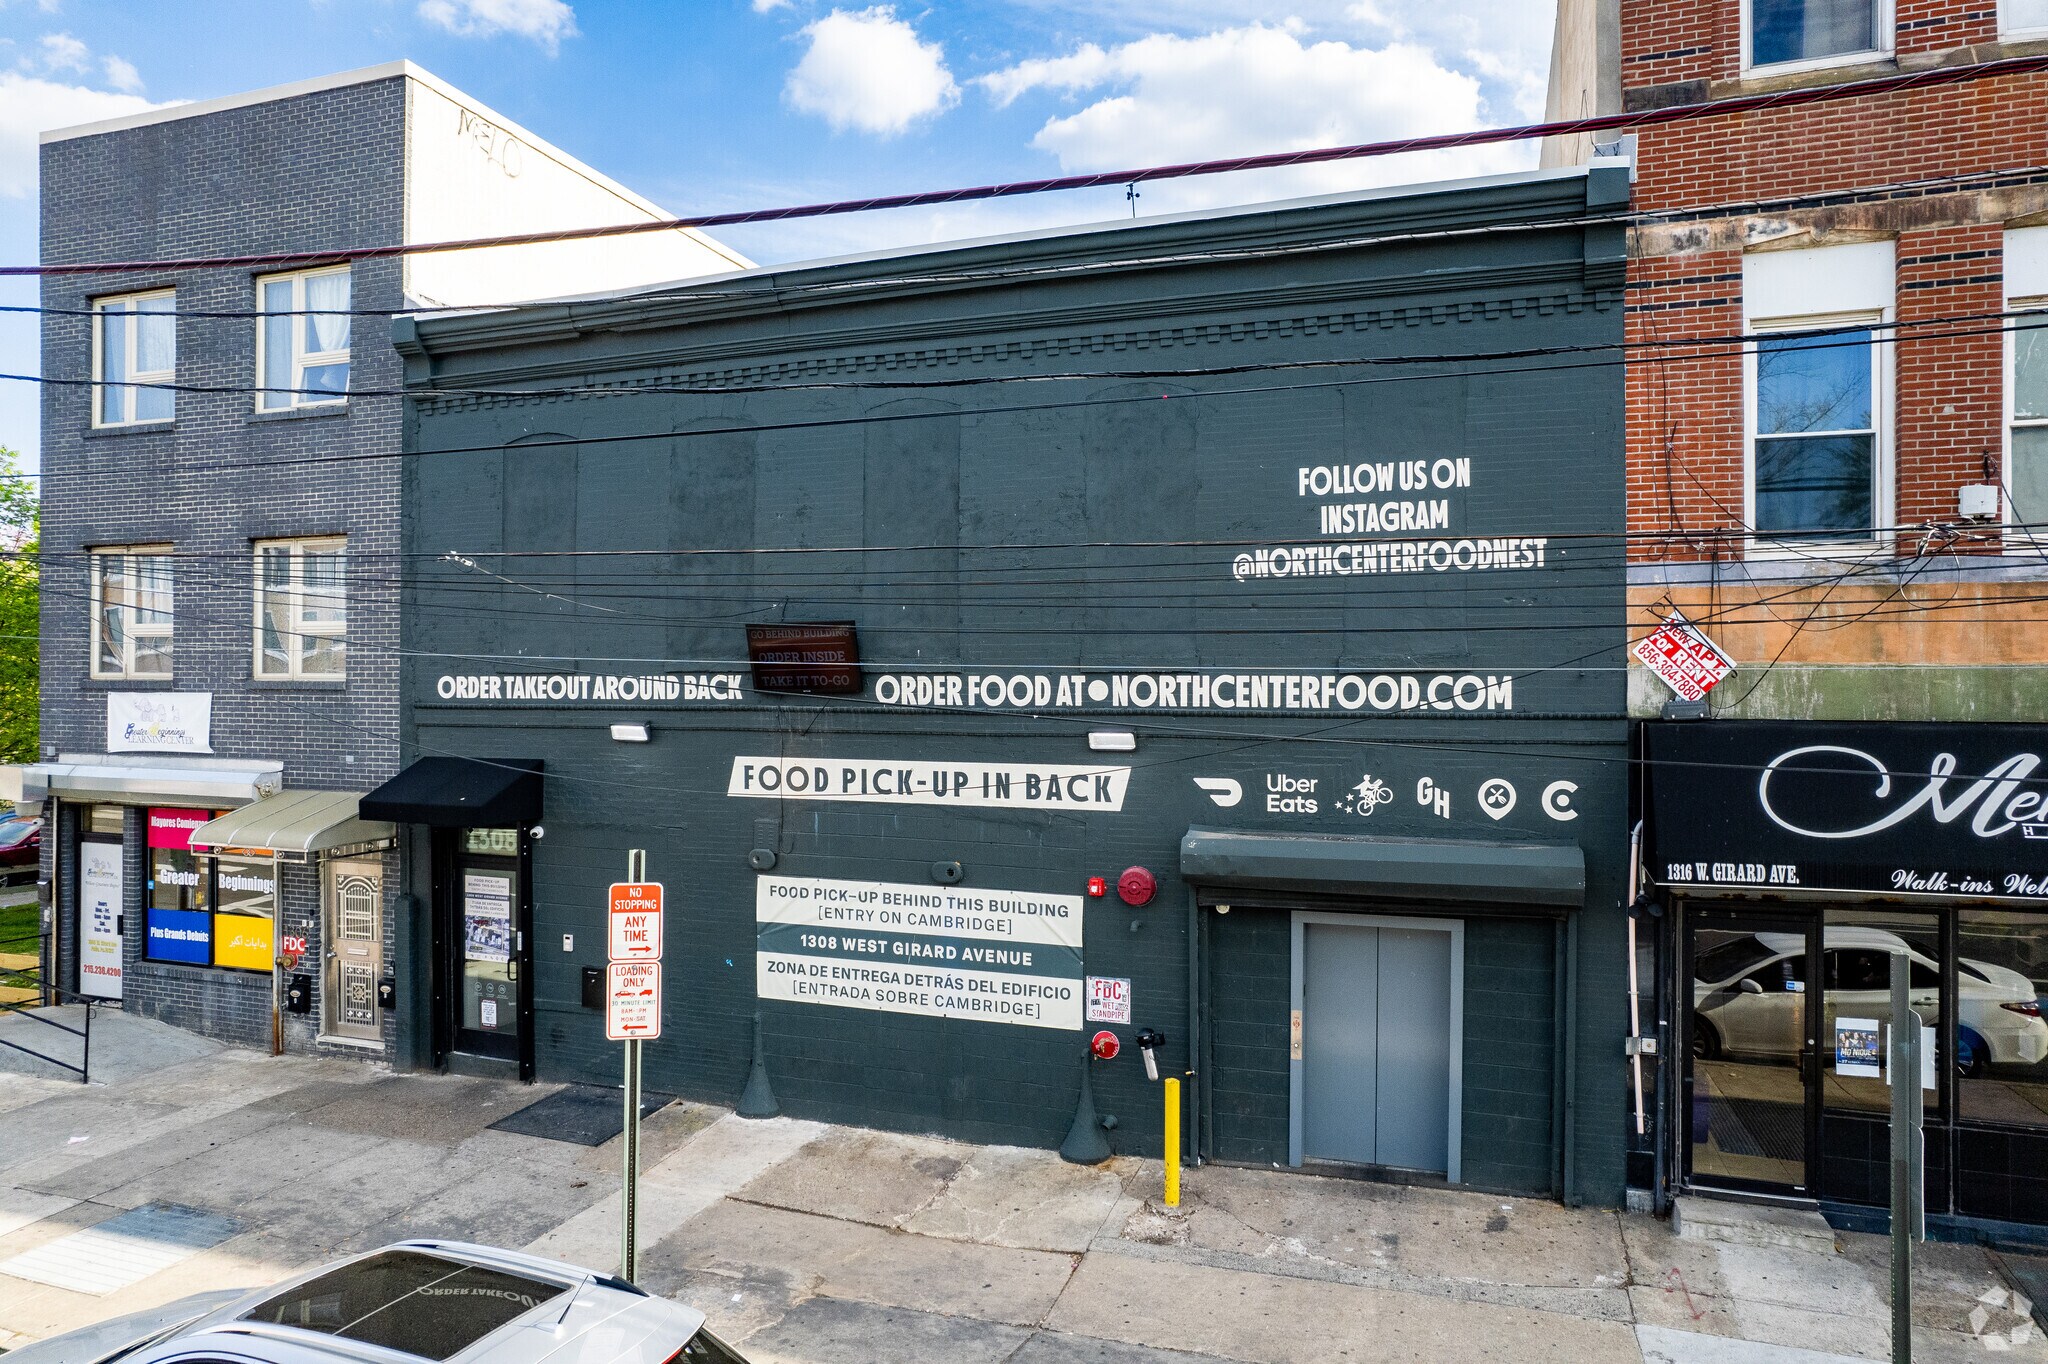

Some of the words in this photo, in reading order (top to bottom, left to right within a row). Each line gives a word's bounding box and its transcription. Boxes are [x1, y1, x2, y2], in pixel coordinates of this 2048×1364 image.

[1299, 462, 1394, 496] FOLLOW
[1399, 460, 1427, 491] US
[1431, 457, 1471, 489] ON
[1321, 499, 1448, 534] INSTAGRAM
[1233, 538, 1547, 583] @NORTHCENTERFOODNEST
[751, 630, 764, 639] GO
[766, 629, 801, 639] BEHIND
[803, 628, 850, 638] BUILDING
[758, 651, 800, 662] ORDER
[802, 650, 846, 662] INSIDE
[1649, 627, 1675, 652] For
[1671, 649, 1717, 687] RENT
[1689, 643, 1728, 676] APT.
[761, 676, 794, 686] TAKE
[796, 676, 808, 686] IT
[812, 675, 850, 686] TO-GO
[1637, 643, 1701, 701] 856-304-7880
[437, 675, 501, 699] ORDER
[504, 675, 591, 699] TAKEOUT
[593, 675, 680, 700] AROUND
[684, 675, 743, 700] BACK
[875, 675, 963, 706] ORDER
[968, 675, 1051, 707] FOOD
[1055, 675, 1086, 707] AT
[1112, 675, 1512, 710] NORTHCENTERFOOD.COM
[128, 736, 166, 744] LEARNING
[167, 736, 195, 745] CENTER
[743, 764, 828, 792] FOOD
[842, 769, 968, 798] PICK-UP
[982, 772, 1010, 800] IN
[1025, 773, 1112, 803] BACK
[1266, 773, 1318, 793] Uber
[1266, 795, 1318, 814] Eats
[151, 816, 176, 828] Mayores
[160, 868, 200, 886] Greater
[218, 873, 274, 894] Beginnings
[1667, 863, 1693, 881] 1316
[1695, 862, 1709, 881] W.
[1712, 862, 1766, 883] GIRARD
[1769, 864, 1800, 884] AVE.
[1891, 869, 1994, 893] Walk-ins
[629, 887, 642, 898] NO
[769, 885, 809, 898] FOOD
[814, 888, 878, 904] PICK-UP
[882, 892, 942, 908] BEHIND
[946, 897, 984, 911] THIS
[989, 899, 1069, 918] BUILDING
[614, 899, 657, 910] STOPPING
[625, 916, 647, 928] ANY
[818, 905, 874, 922] [ENTRY
[879, 911, 901, 924] ON
[907, 913, 1012, 935] CAMBRIDGE]
[150, 926, 164, 938] Plus
[164, 928, 187, 940] Grands
[623, 930, 648, 942] TIME
[283, 936, 305, 951] FDC
[800, 934, 837, 949] 1308
[842, 937, 887, 952] WEST
[892, 942, 957, 960] GIRARD
[961, 947, 1032, 966] AVENUE
[615, 966, 653, 976] LOADING
[767, 960, 806, 975] ZONA
[809, 965, 828, 978] DE
[832, 967, 900, 984] ENTREGA
[904, 973, 964, 991] DETRÁS
[968, 979, 997, 994] DEL
[1001, 982, 1071, 1001] EDIFICIO
[623, 978, 645, 987] ONLY
[1095, 980, 1121, 1000] FDC
[793, 980, 871, 1000] [ENTRADA
[875, 989, 929, 1006] SOBRE
[934, 995, 1040, 1019] CAMBRIDGE]
[1102, 1001, 1115, 1010] WET
[1091, 1009, 1125, 1020] STANDPIPE
